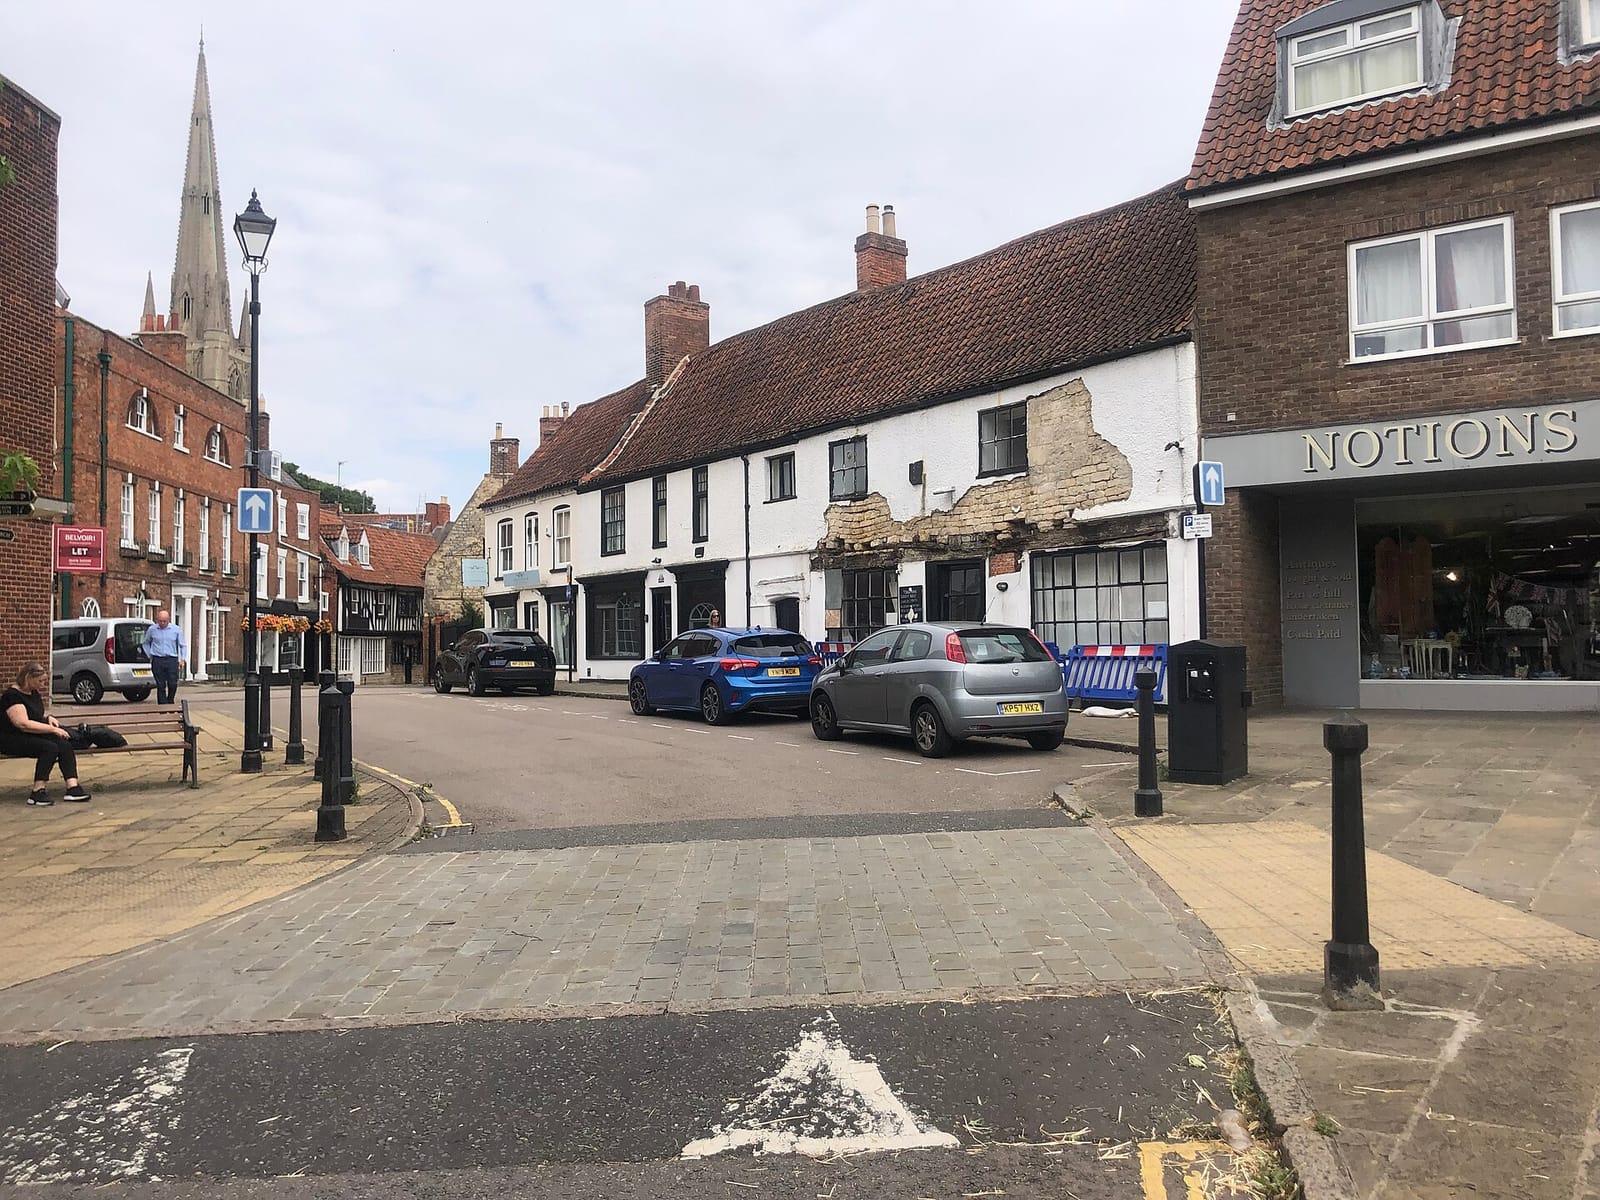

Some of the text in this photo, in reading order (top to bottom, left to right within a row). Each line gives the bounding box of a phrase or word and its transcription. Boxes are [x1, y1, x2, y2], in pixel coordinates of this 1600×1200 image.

[1302, 410, 1578, 472] NOTIONS
[72, 547, 88, 556] LET
[1003, 703, 1040, 713] KP57 HXZ
